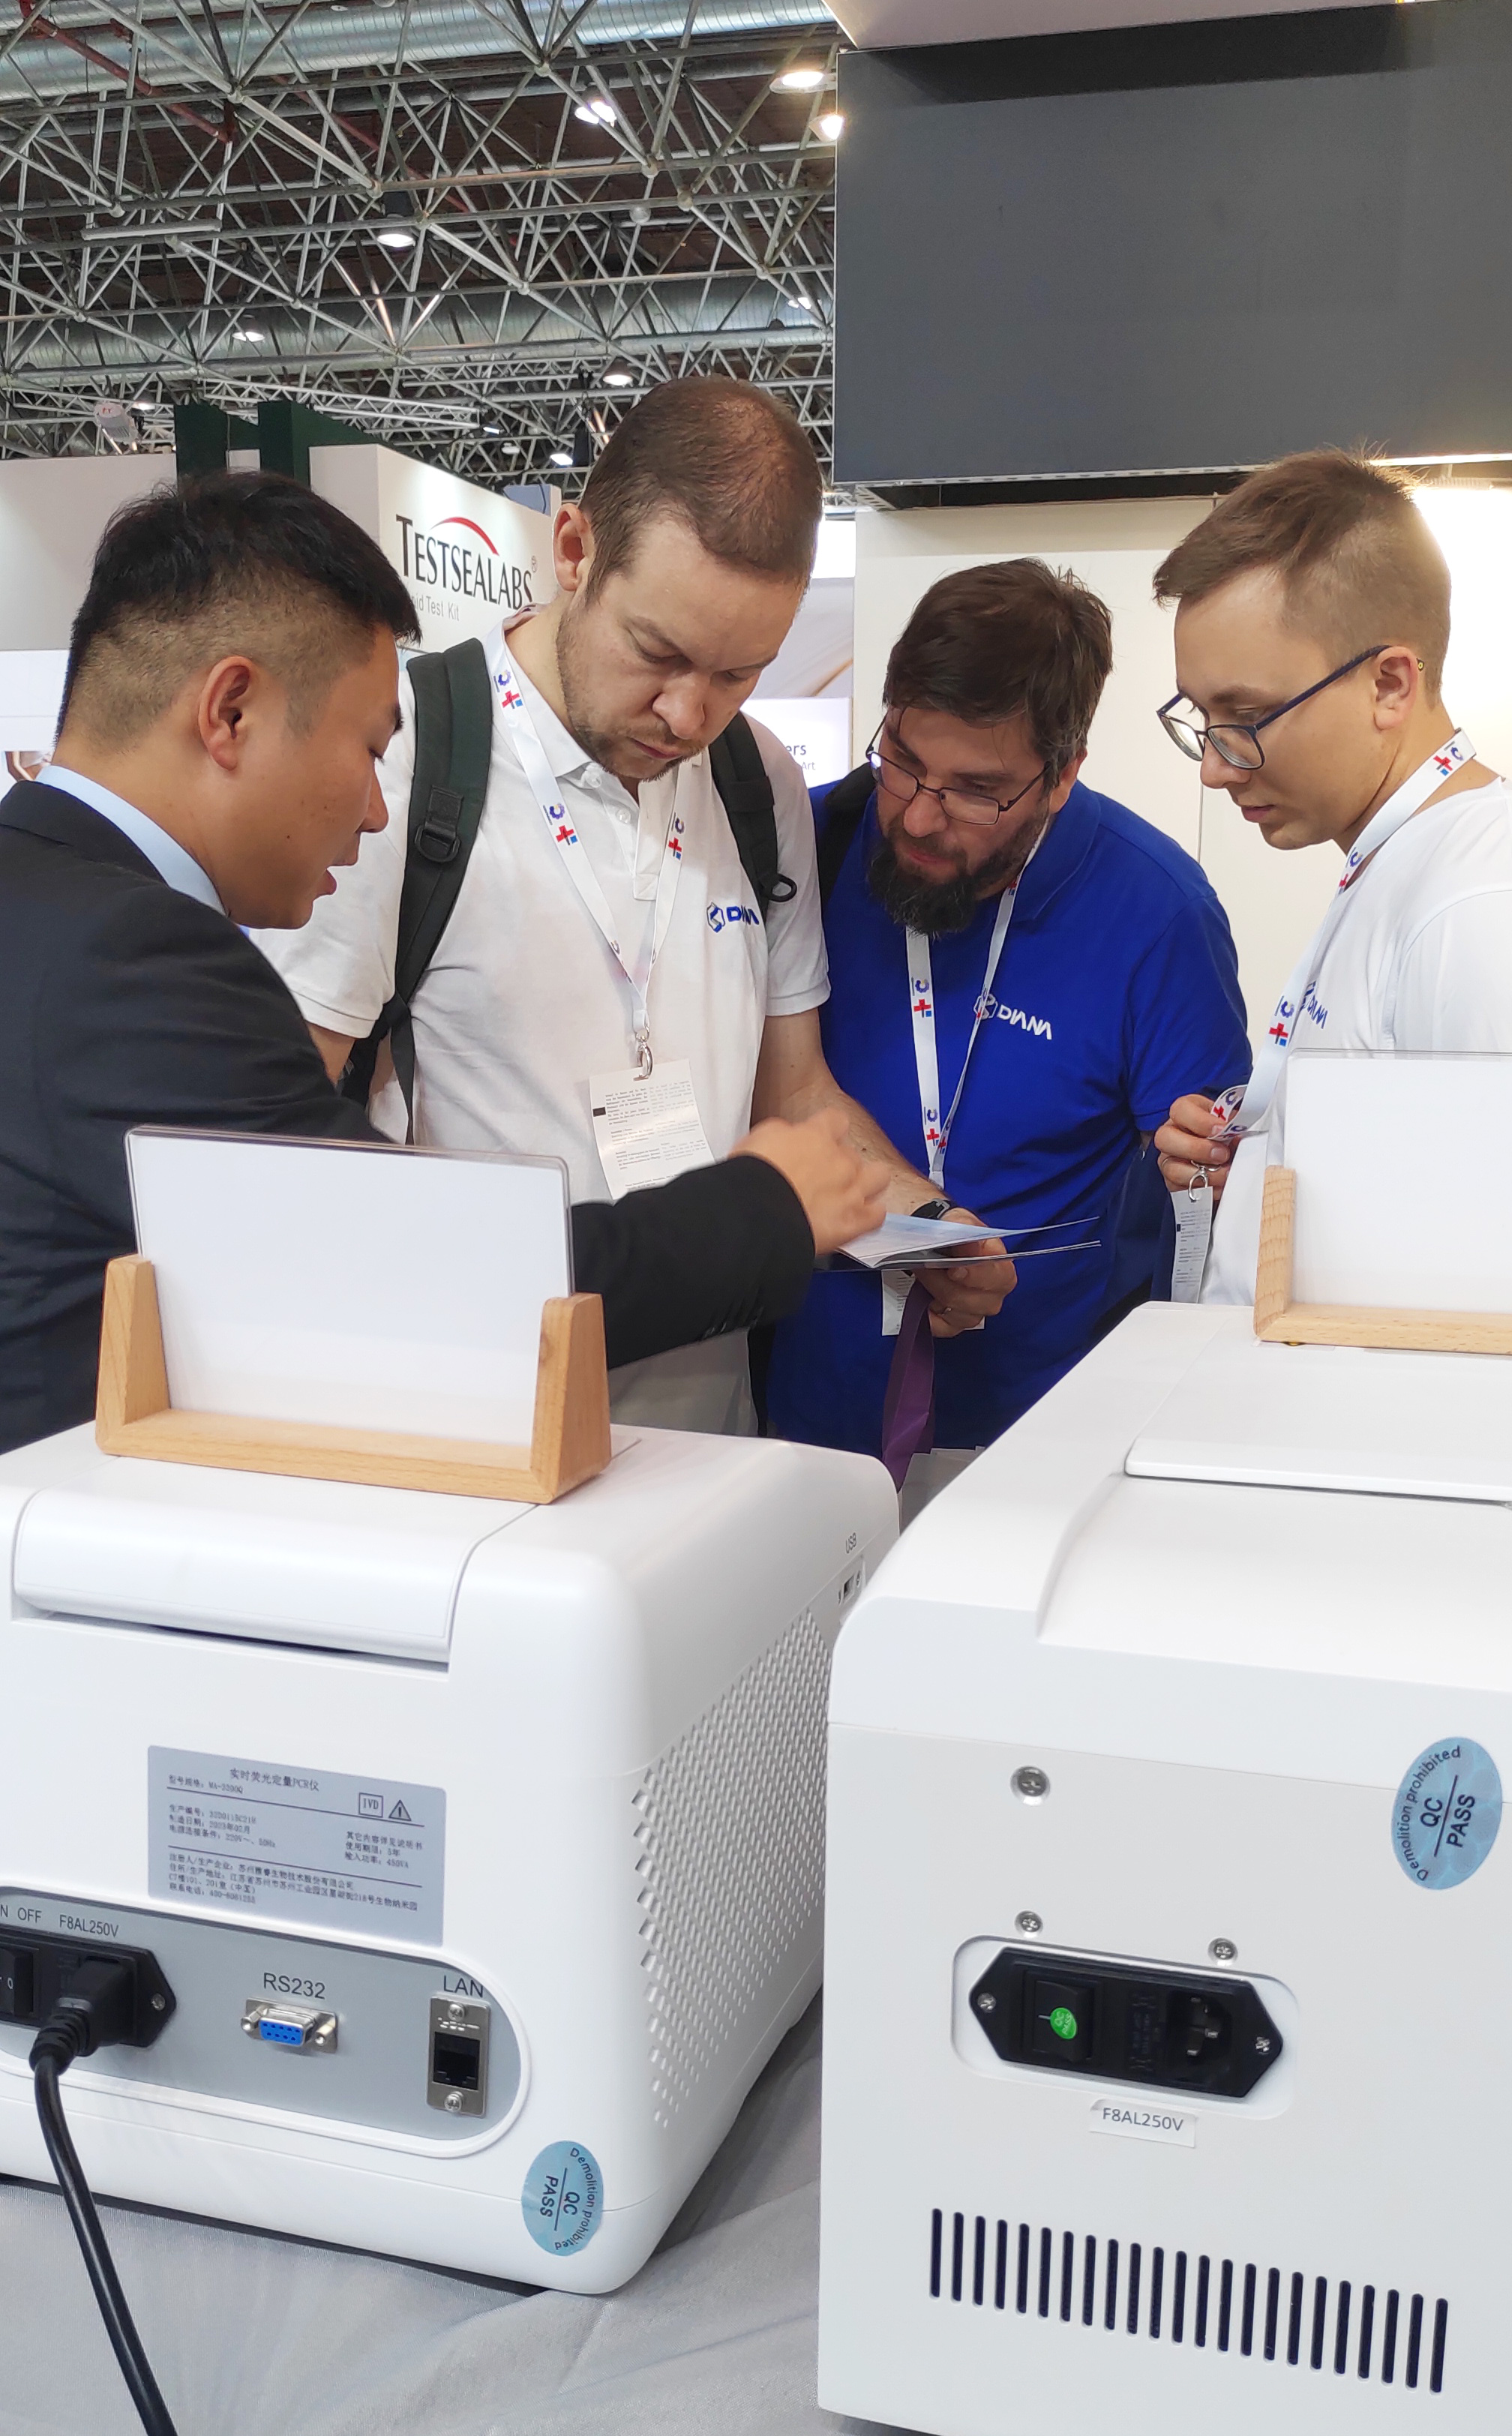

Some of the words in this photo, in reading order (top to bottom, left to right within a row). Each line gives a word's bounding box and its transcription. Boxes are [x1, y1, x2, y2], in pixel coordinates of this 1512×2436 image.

[425, 596, 444, 617] Test
[448, 602, 460, 621] Kit
[997, 1004, 1052, 1040] DIANA
[845, 1532, 856, 1553] USB
[1406, 1745, 1461, 1804] prohibited
[363, 1798, 380, 1810] IVD
[1420, 1797, 1443, 1828] QC
[1446, 1794, 1476, 1848] PASS
[1397, 1805, 1429, 1881] Demolition
[17, 1907, 42, 1923] OFF
[59, 1914, 119, 1937] F8AL250V
[263, 1972, 326, 2000] RS232
[443, 1975, 484, 1998] LAN
[1102, 2107, 1184, 2132] F8AL250V
[570, 2147, 598, 2207] Demolition
[540, 2175, 559, 2218] PASS
[563, 2192, 580, 2216] QC
[554, 2210, 592, 2250] prohibited
